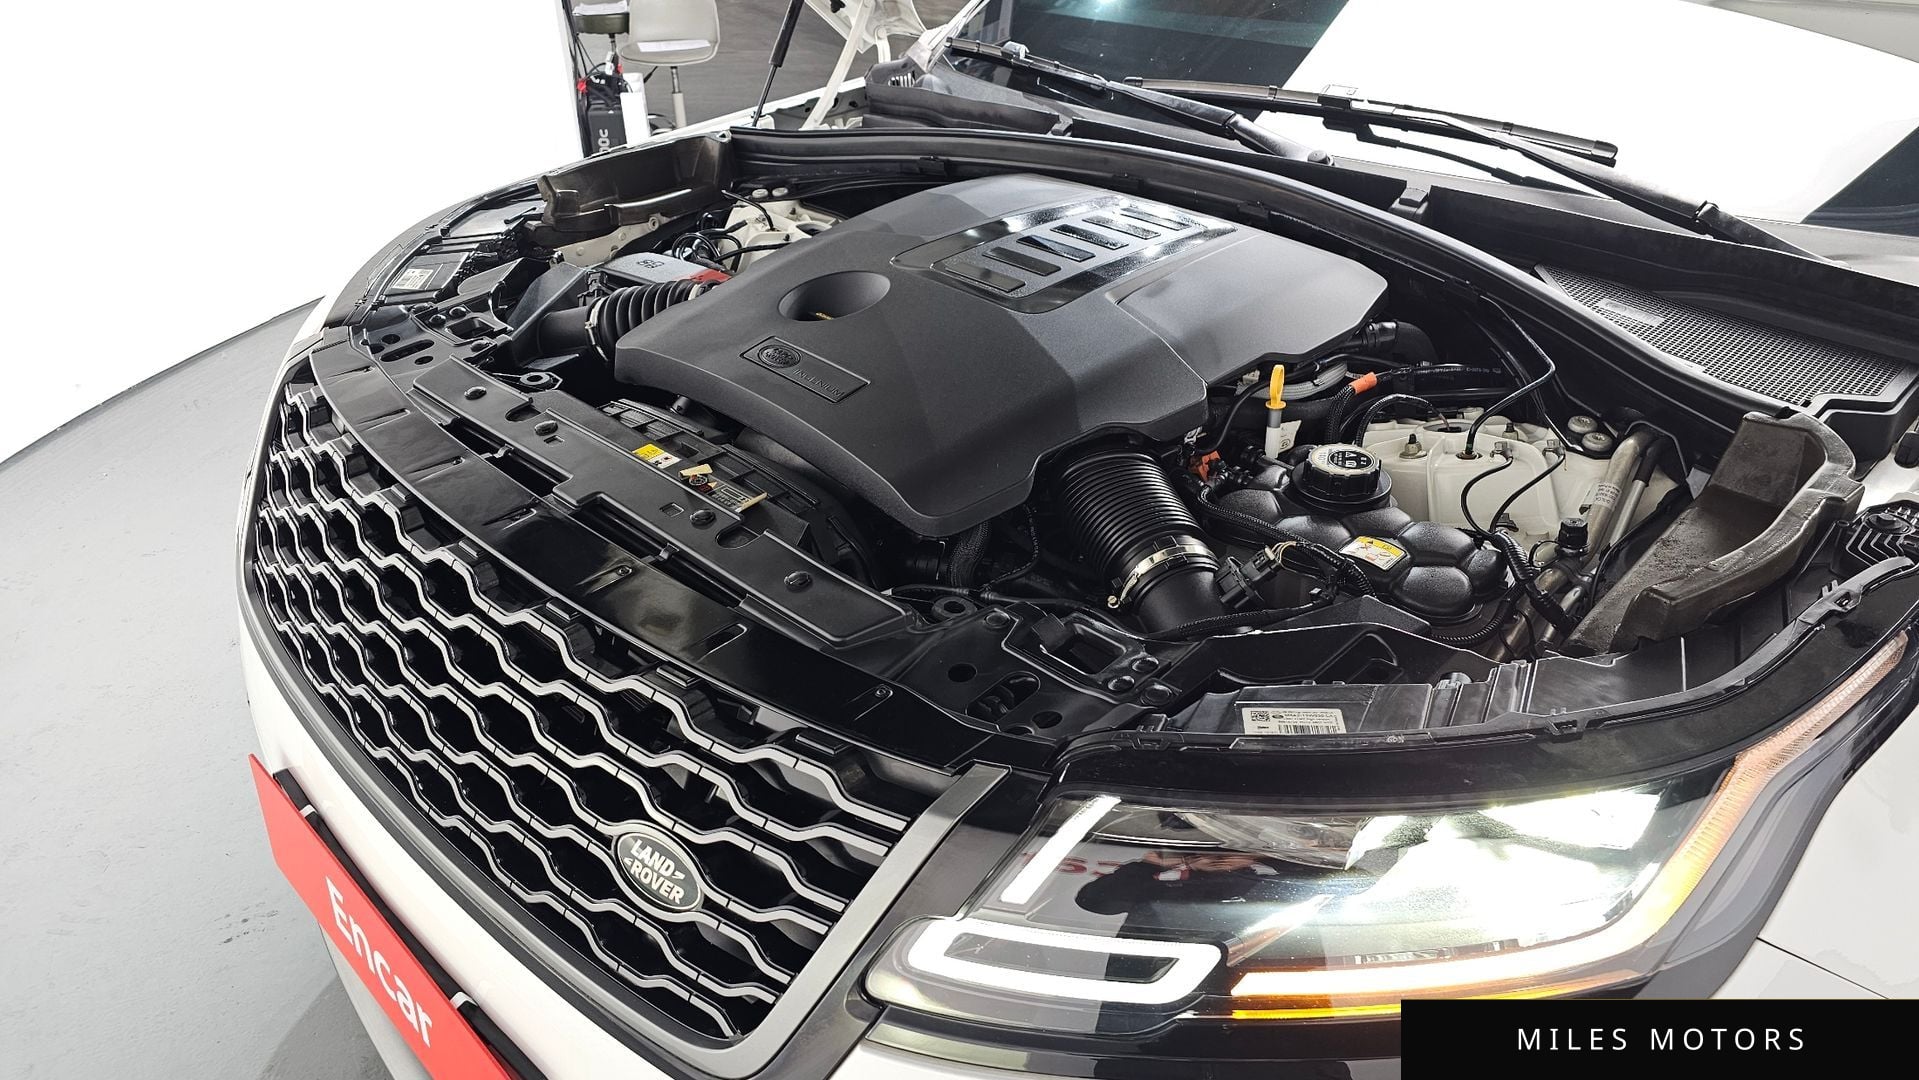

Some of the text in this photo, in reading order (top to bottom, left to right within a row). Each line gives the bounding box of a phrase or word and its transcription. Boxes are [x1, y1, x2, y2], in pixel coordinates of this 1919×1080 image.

[629, 858, 686, 905] ROVER
[630, 839, 676, 878] LAND
[325, 875, 434, 1049] Encar
